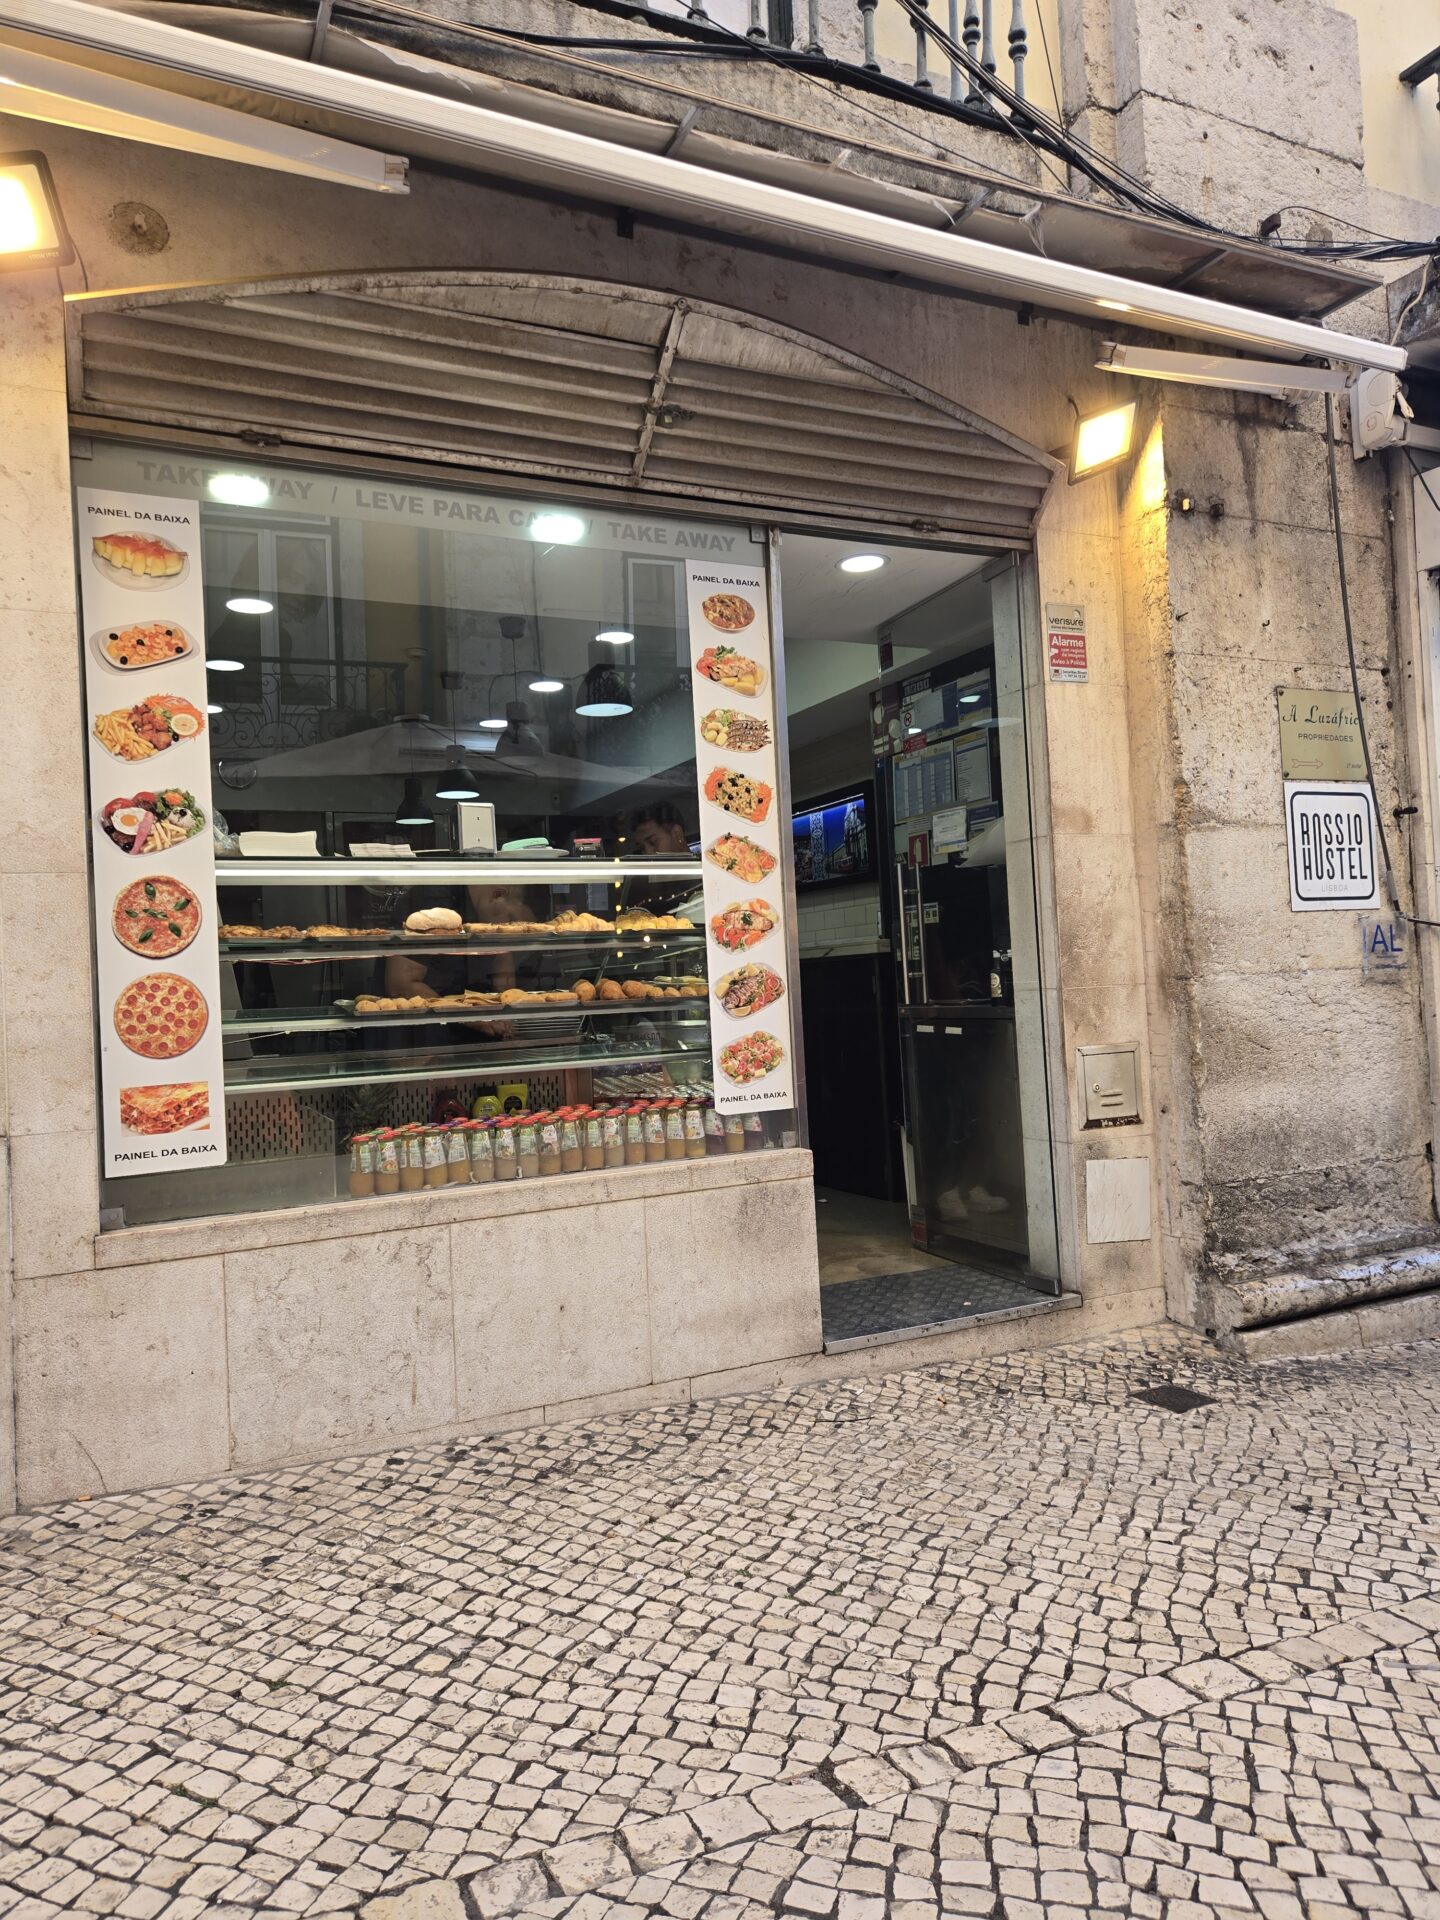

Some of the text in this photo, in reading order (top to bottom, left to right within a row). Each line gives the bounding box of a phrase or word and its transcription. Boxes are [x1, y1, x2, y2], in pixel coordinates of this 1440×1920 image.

[87, 506, 190, 525] PAINEL DA BAIXA
[355, 488, 425, 515] LEVE
[433, 499, 501, 525] PARA
[607, 521, 668, 545] TAKE
[674, 530, 736, 553] AWAY
[692, 574, 721, 584] PAINEL
[736, 578, 760, 587] BAIXA
[1049, 617, 1084, 626] verisure
[1051, 635, 1084, 648] Alarme
[1305, 704, 1365, 728] Luzáfric
[1298, 733, 1354, 742] PROPRIEDADES
[1300, 813, 1363, 846] ROSSIO
[1302, 847, 1368, 880] HOSTEL
[1321, 884, 1349, 892] LISBOA
[1371, 924, 1403, 952] AL
[720, 1095, 748, 1104] PAINEL
[763, 1091, 788, 1100] BAIXA
[114, 1144, 218, 1162] PAINEL DA BAIXA
